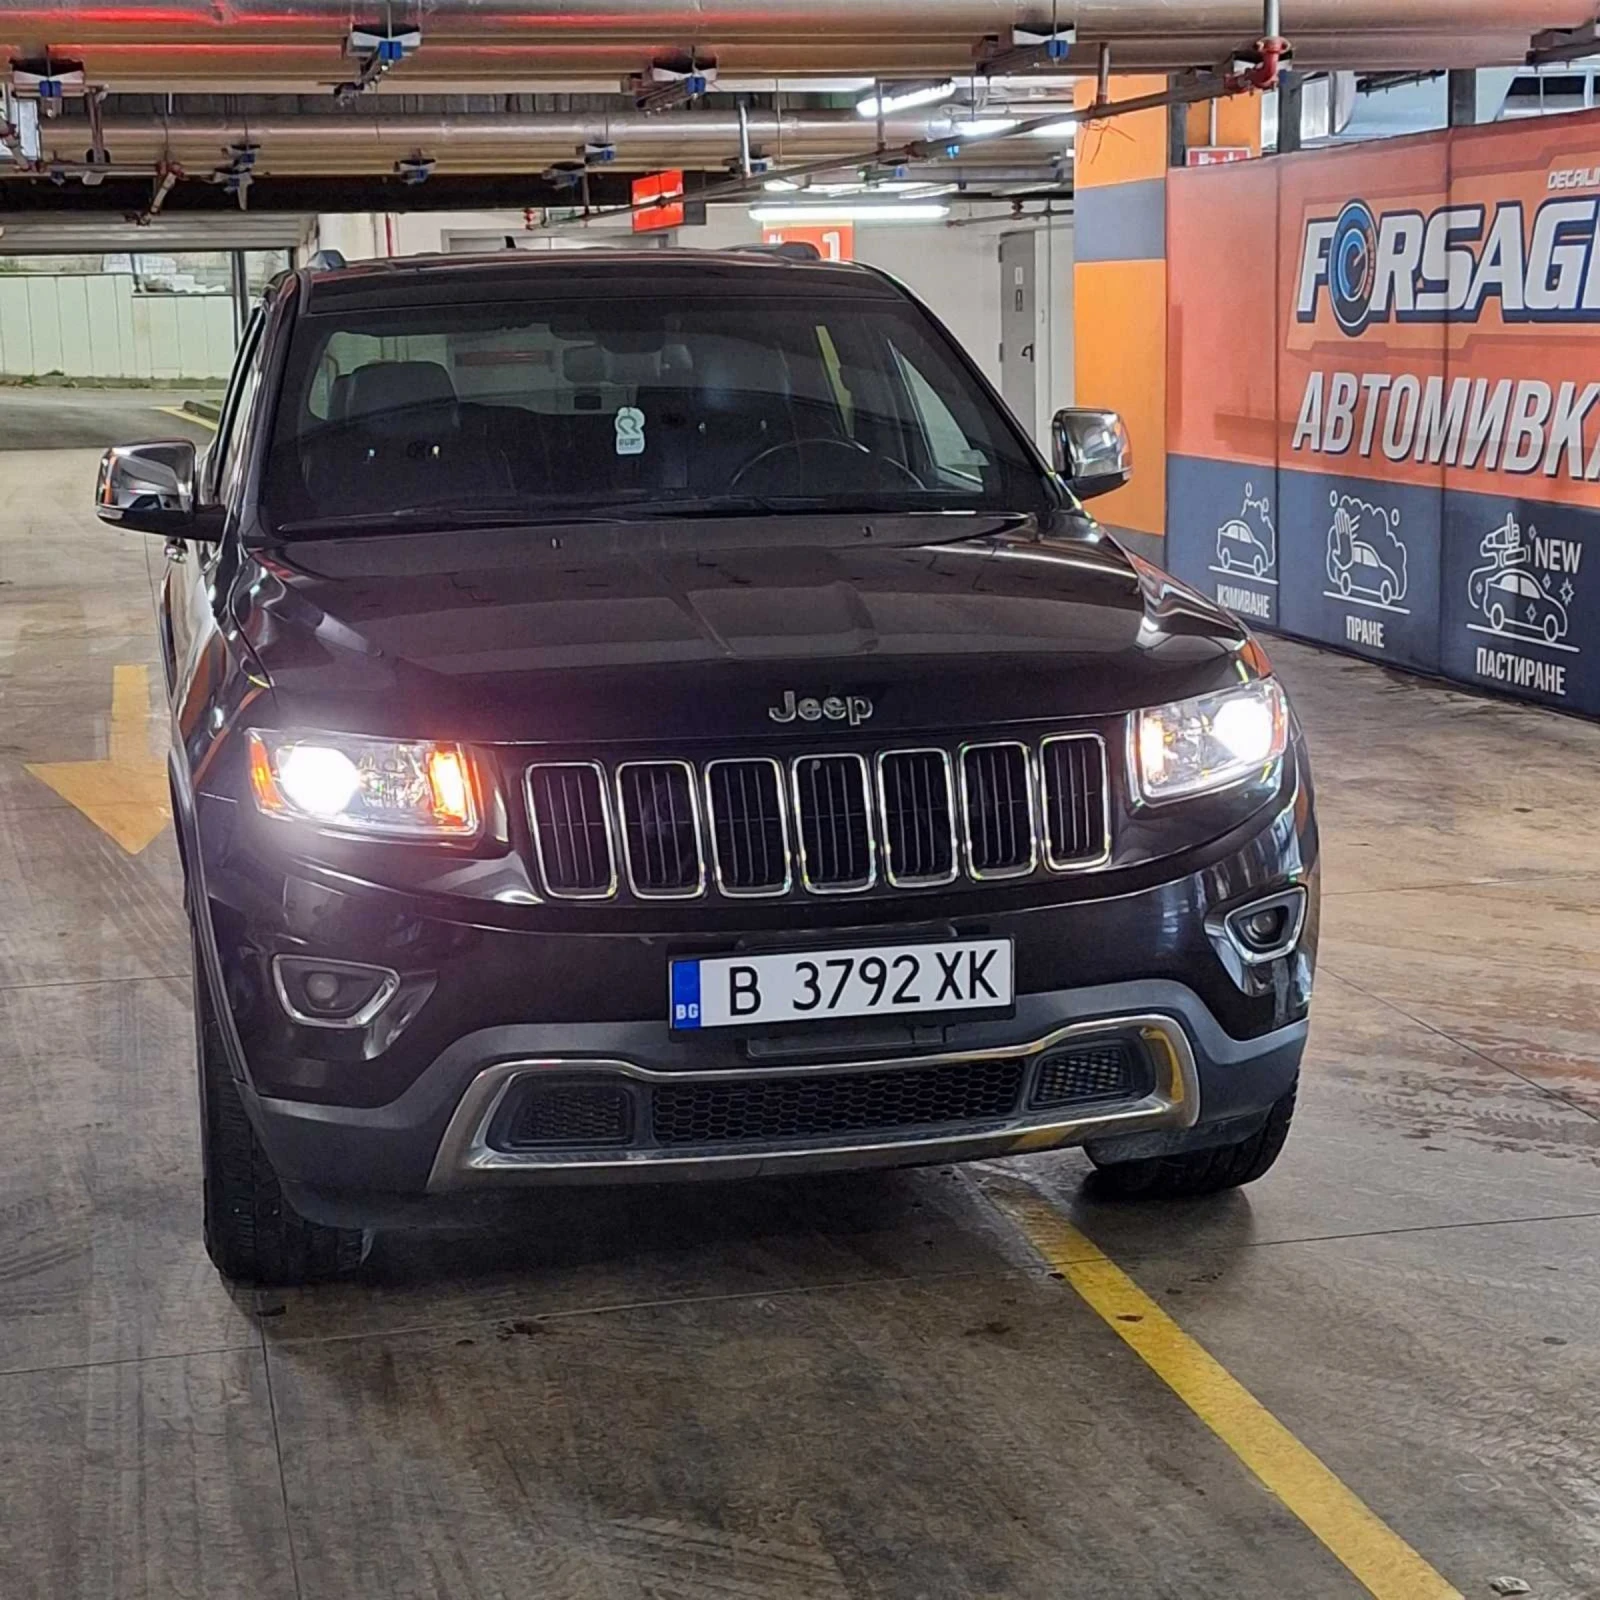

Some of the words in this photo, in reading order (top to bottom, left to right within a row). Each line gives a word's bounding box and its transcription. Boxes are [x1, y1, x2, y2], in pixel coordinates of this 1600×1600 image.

[1535, 537, 1582, 574] NEW
[1346, 615, 1384, 648] ПРАНЕ
[1476, 647, 1566, 695] ПАСТИРАНЕ
[768, 690, 874, 726] Jeep
[728, 966, 762, 1017] B
[792, 954, 921, 1011] 3792
[935, 949, 999, 1001] XK
[675, 1003, 699, 1020] BG
